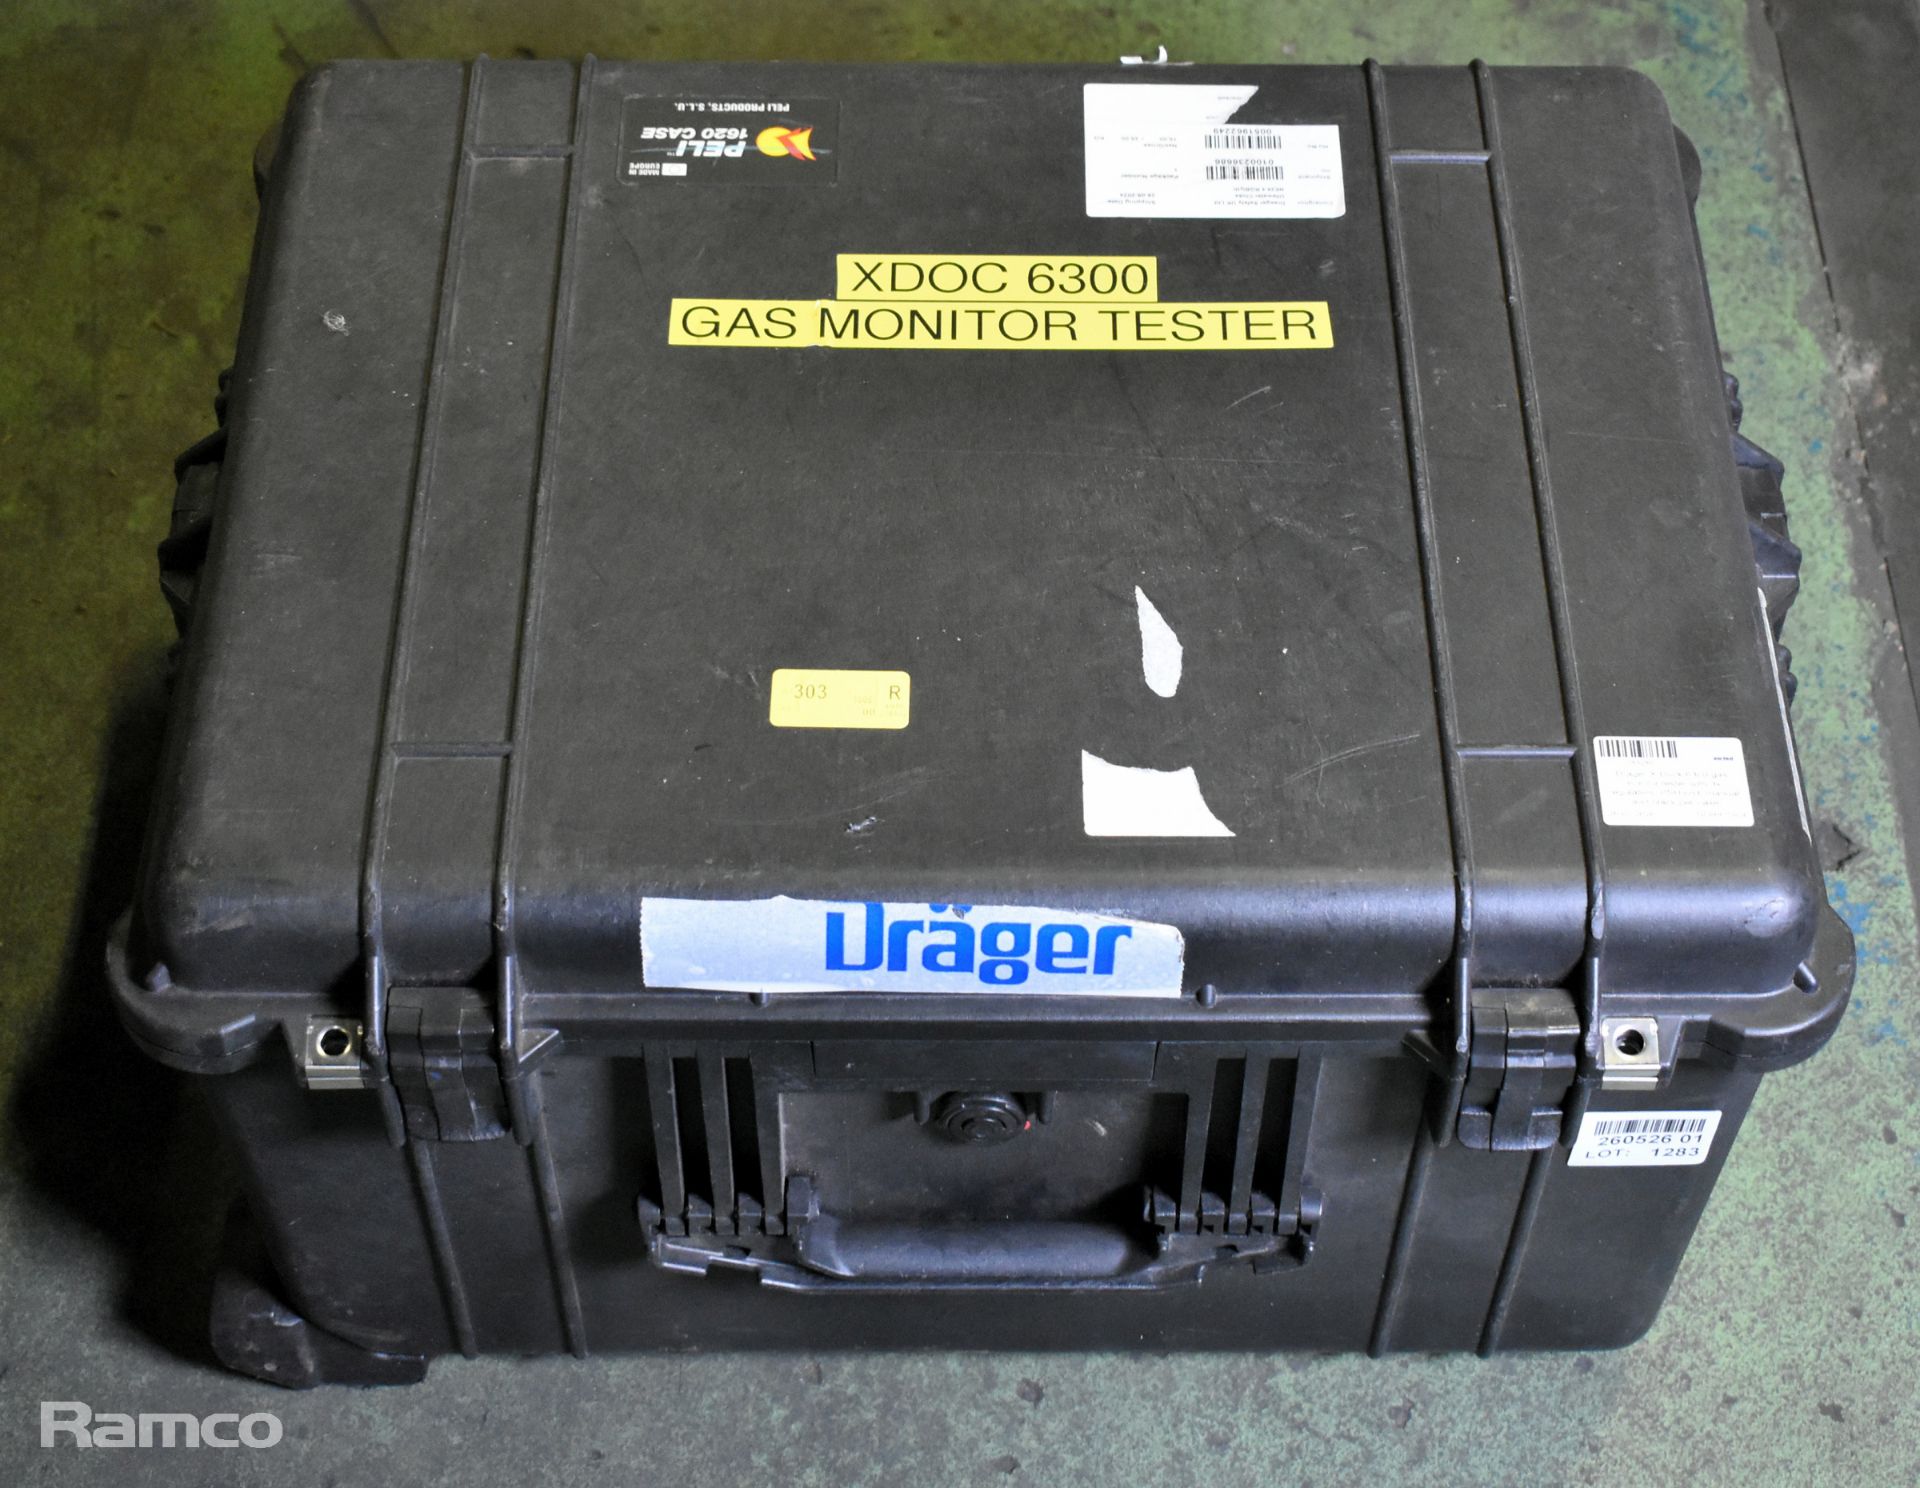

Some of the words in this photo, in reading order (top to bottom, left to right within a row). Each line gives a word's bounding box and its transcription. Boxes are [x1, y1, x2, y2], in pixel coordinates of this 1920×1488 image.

[674, 102, 705, 112] S.L.U.
[707, 102, 765, 112] PRODUCTS,
[767, 103, 790, 112] PELI
[640, 127, 696, 139] CASE
[700, 127, 749, 139] 1620
[675, 140, 747, 157] PELI
[852, 261, 1009, 295] XDOC
[1027, 261, 1151, 295] 6300
[680, 305, 798, 339] GAS
[819, 307, 1077, 341] MONITOR
[1097, 308, 1318, 342] TESTER
[793, 684, 828, 699] 303
[888, 684, 901, 700] R
[825, 902, 1132, 985] Dräger
[1598, 1134, 1672, 1146] 260526
[1680, 1134, 1703, 1143] 01
[1584, 1148, 1630, 1159] LOT:
[1652, 1147, 1700, 1157] 1283
